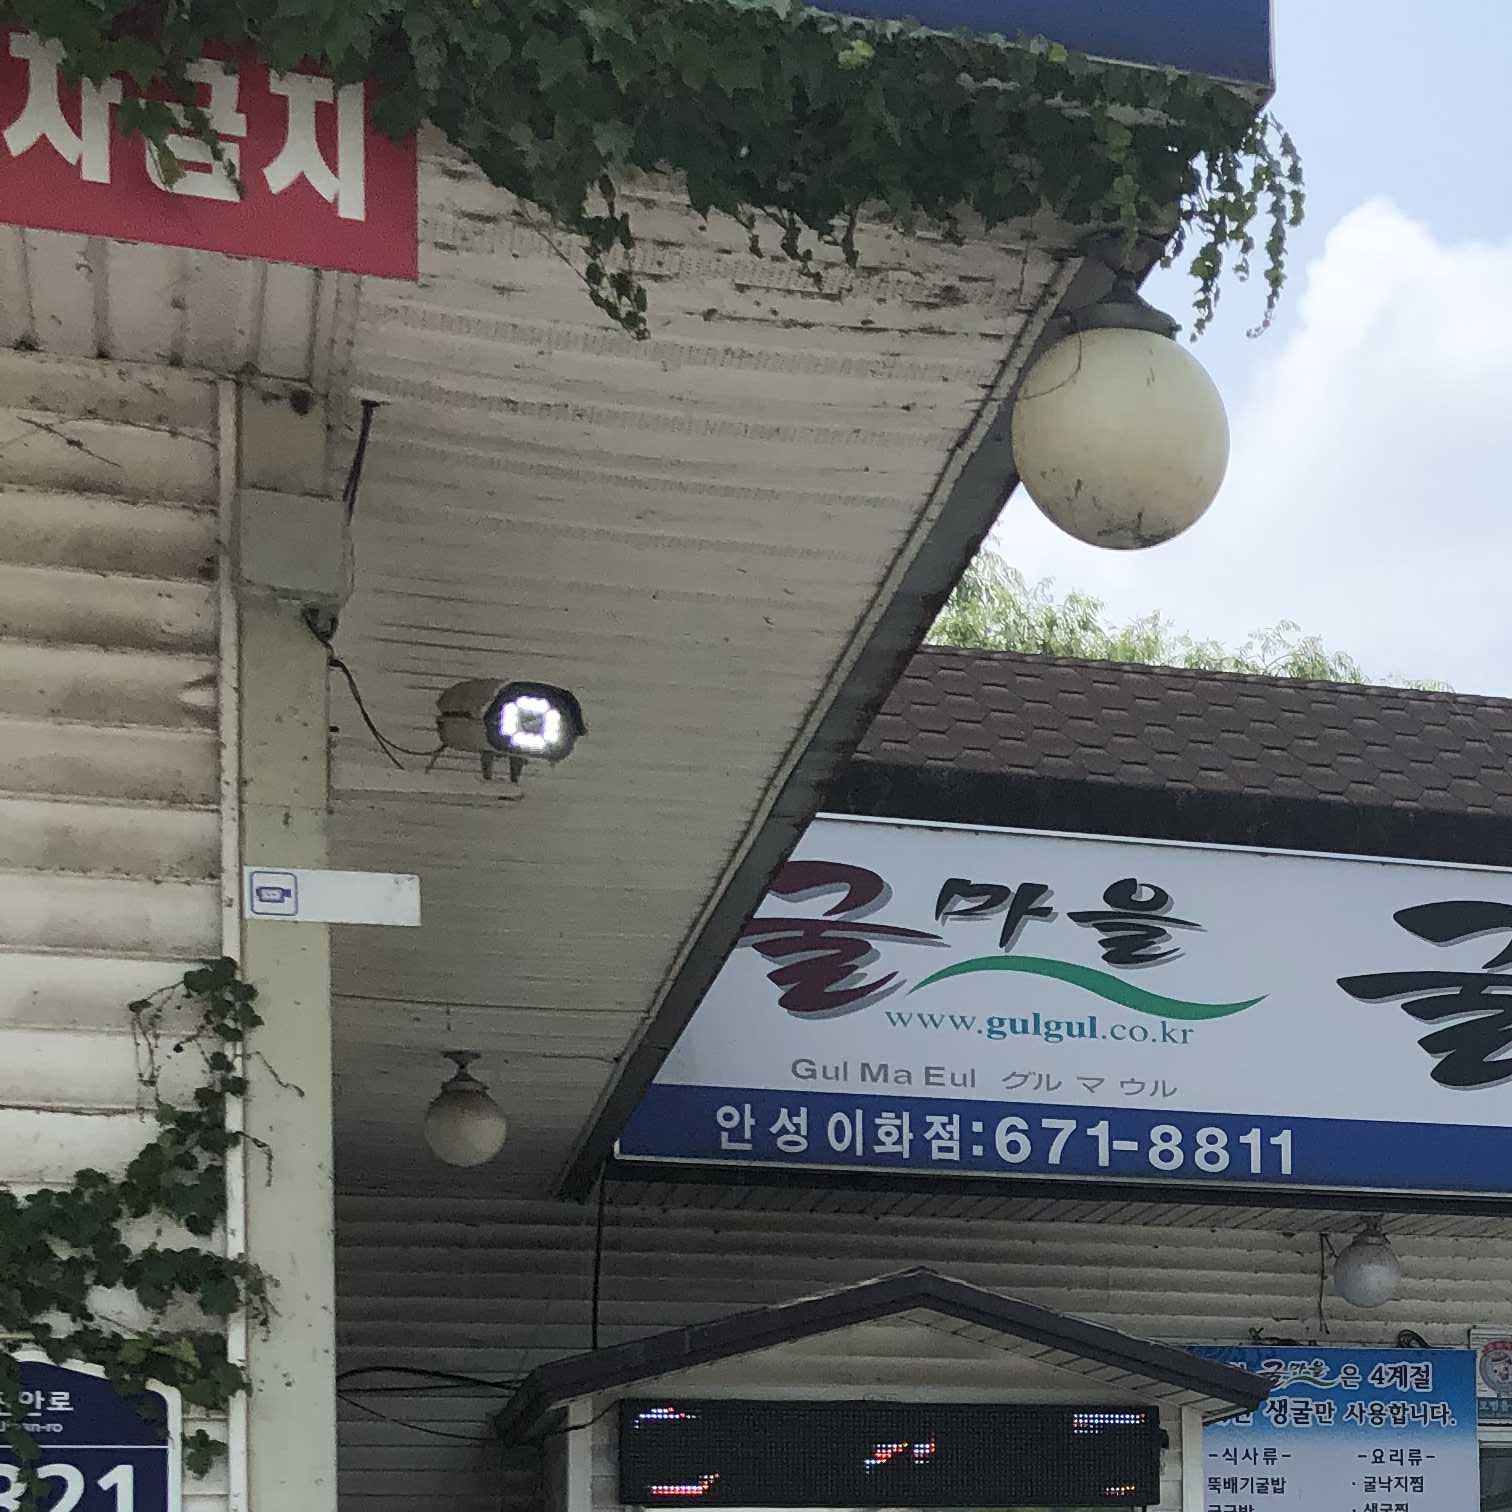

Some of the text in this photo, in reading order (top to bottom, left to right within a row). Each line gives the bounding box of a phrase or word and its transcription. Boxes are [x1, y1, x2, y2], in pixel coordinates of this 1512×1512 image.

[885, 1008, 1195, 1047] www.gulgul.co.kr
[790, 1057, 977, 1091] Gul Ma Eul
[1001, 1070, 1179, 1099] グル マ ウル
[715, 1102, 810, 1154] 안성
[1367, 1363, 1432, 1391] 4계절
[1264, 1397, 1336, 1426] 생굴만
[1344, 1402, 1457, 1427] 사용합니다.
[1207, 1476, 1287, 1495] 뚝배기굴밥
[1363, 1475, 1424, 1493] 굴낙지찜
